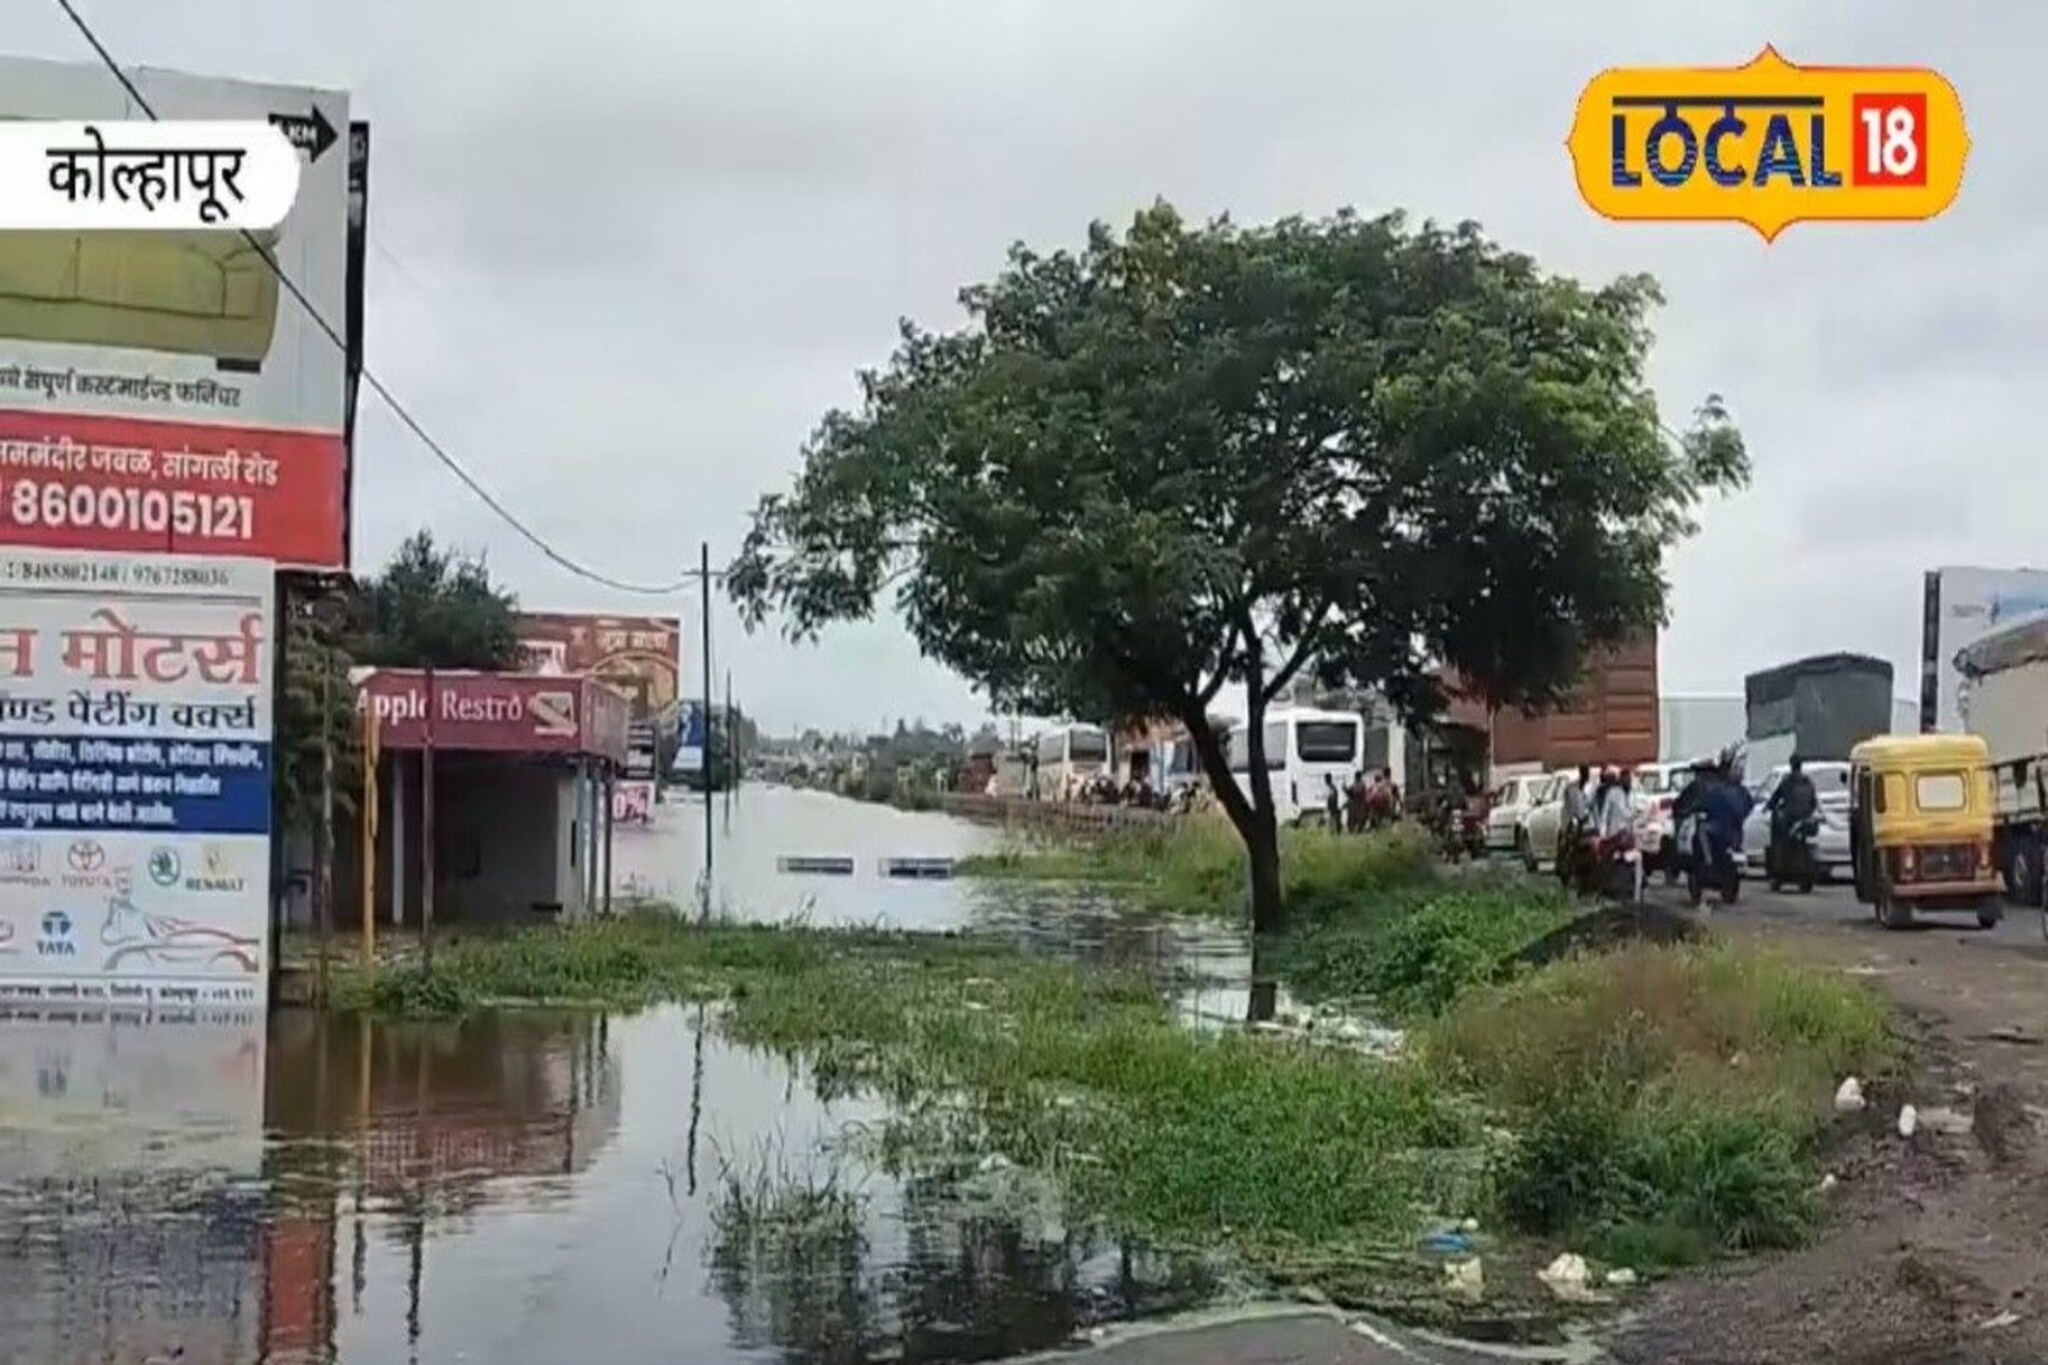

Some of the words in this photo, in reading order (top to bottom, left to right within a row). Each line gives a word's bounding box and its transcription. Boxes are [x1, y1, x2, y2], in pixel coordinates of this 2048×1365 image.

[12, 479, 252, 539] 8600105121
[60, 608, 262, 683] मोटर्स
[186, 878, 245, 892] RENAULT
[37, 941, 76, 955] TATA
